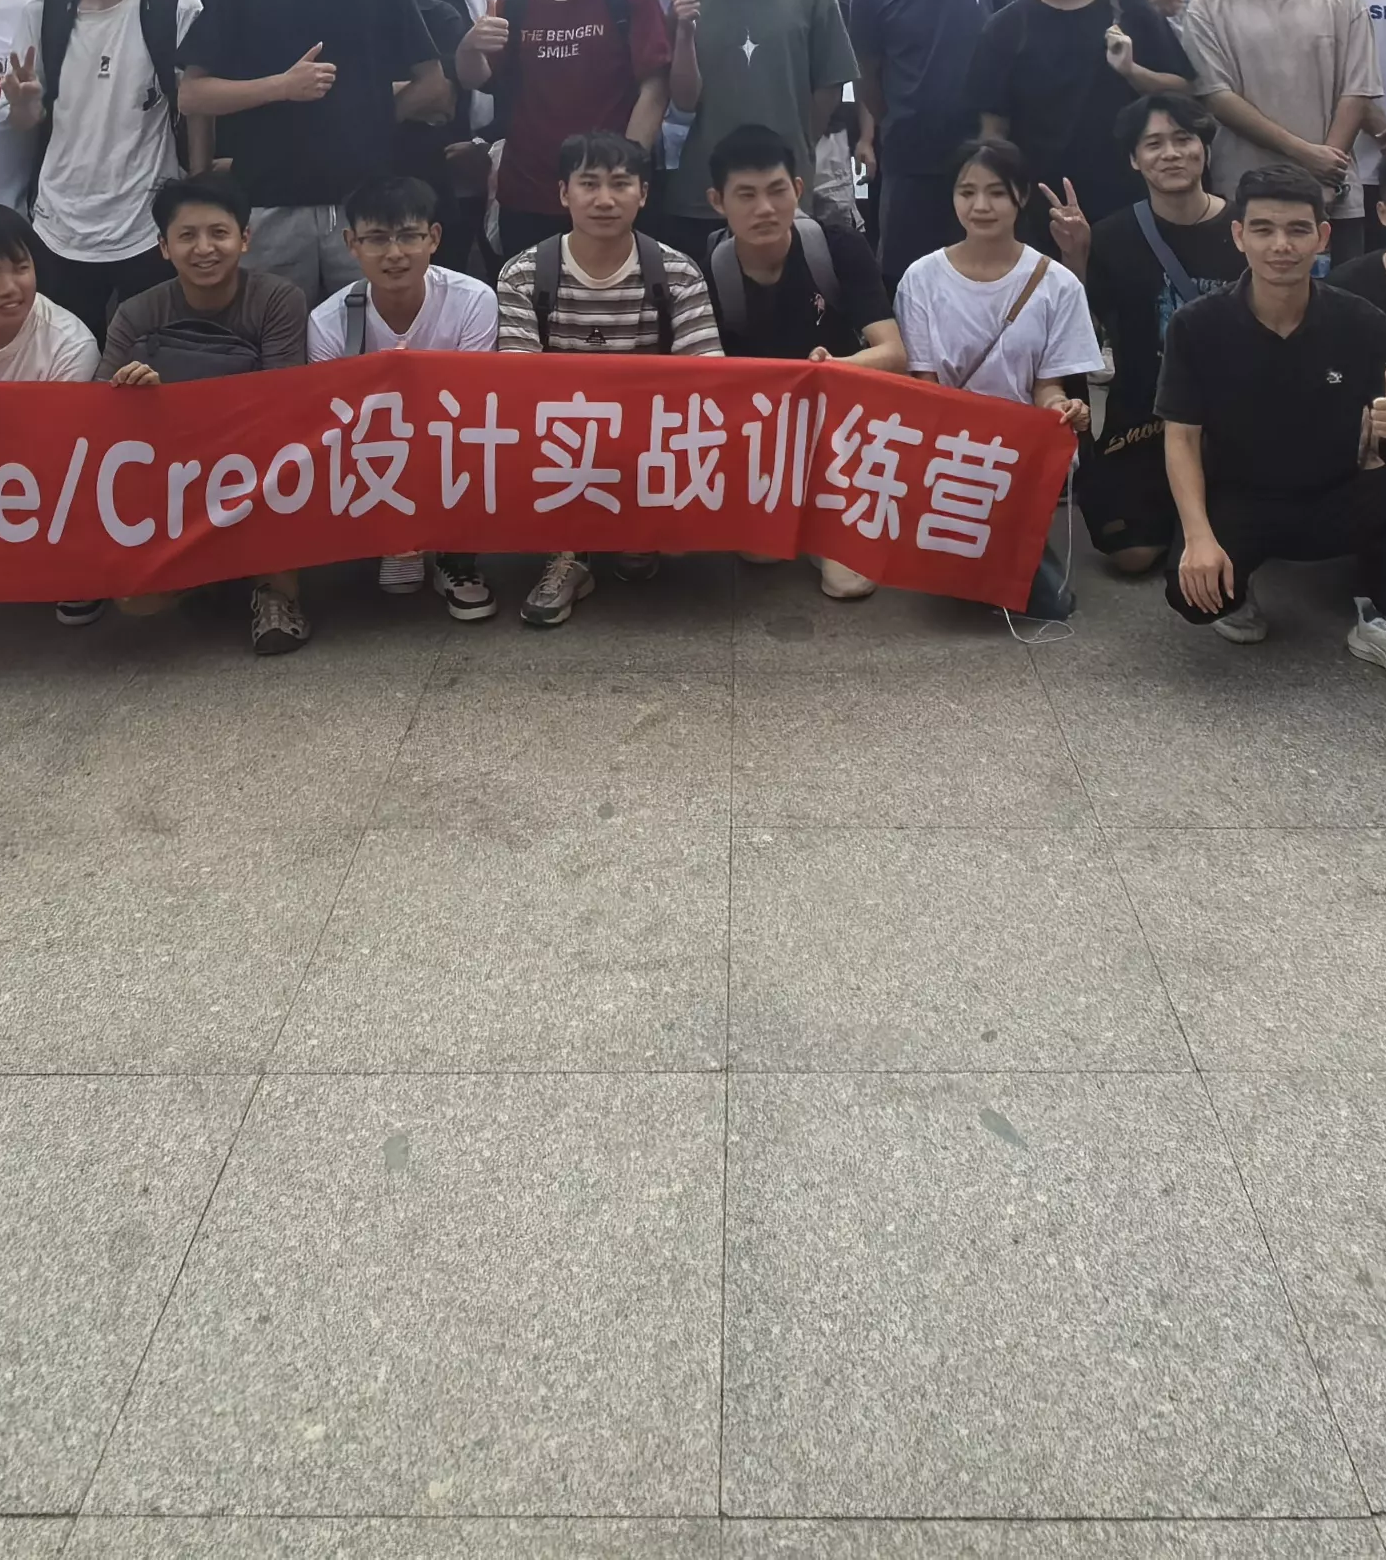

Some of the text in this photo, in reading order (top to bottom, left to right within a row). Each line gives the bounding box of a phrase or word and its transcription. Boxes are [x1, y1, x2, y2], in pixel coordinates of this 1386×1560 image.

[521, 24, 604, 42] THE BENGEN
[537, 43, 580, 58] SMILE
